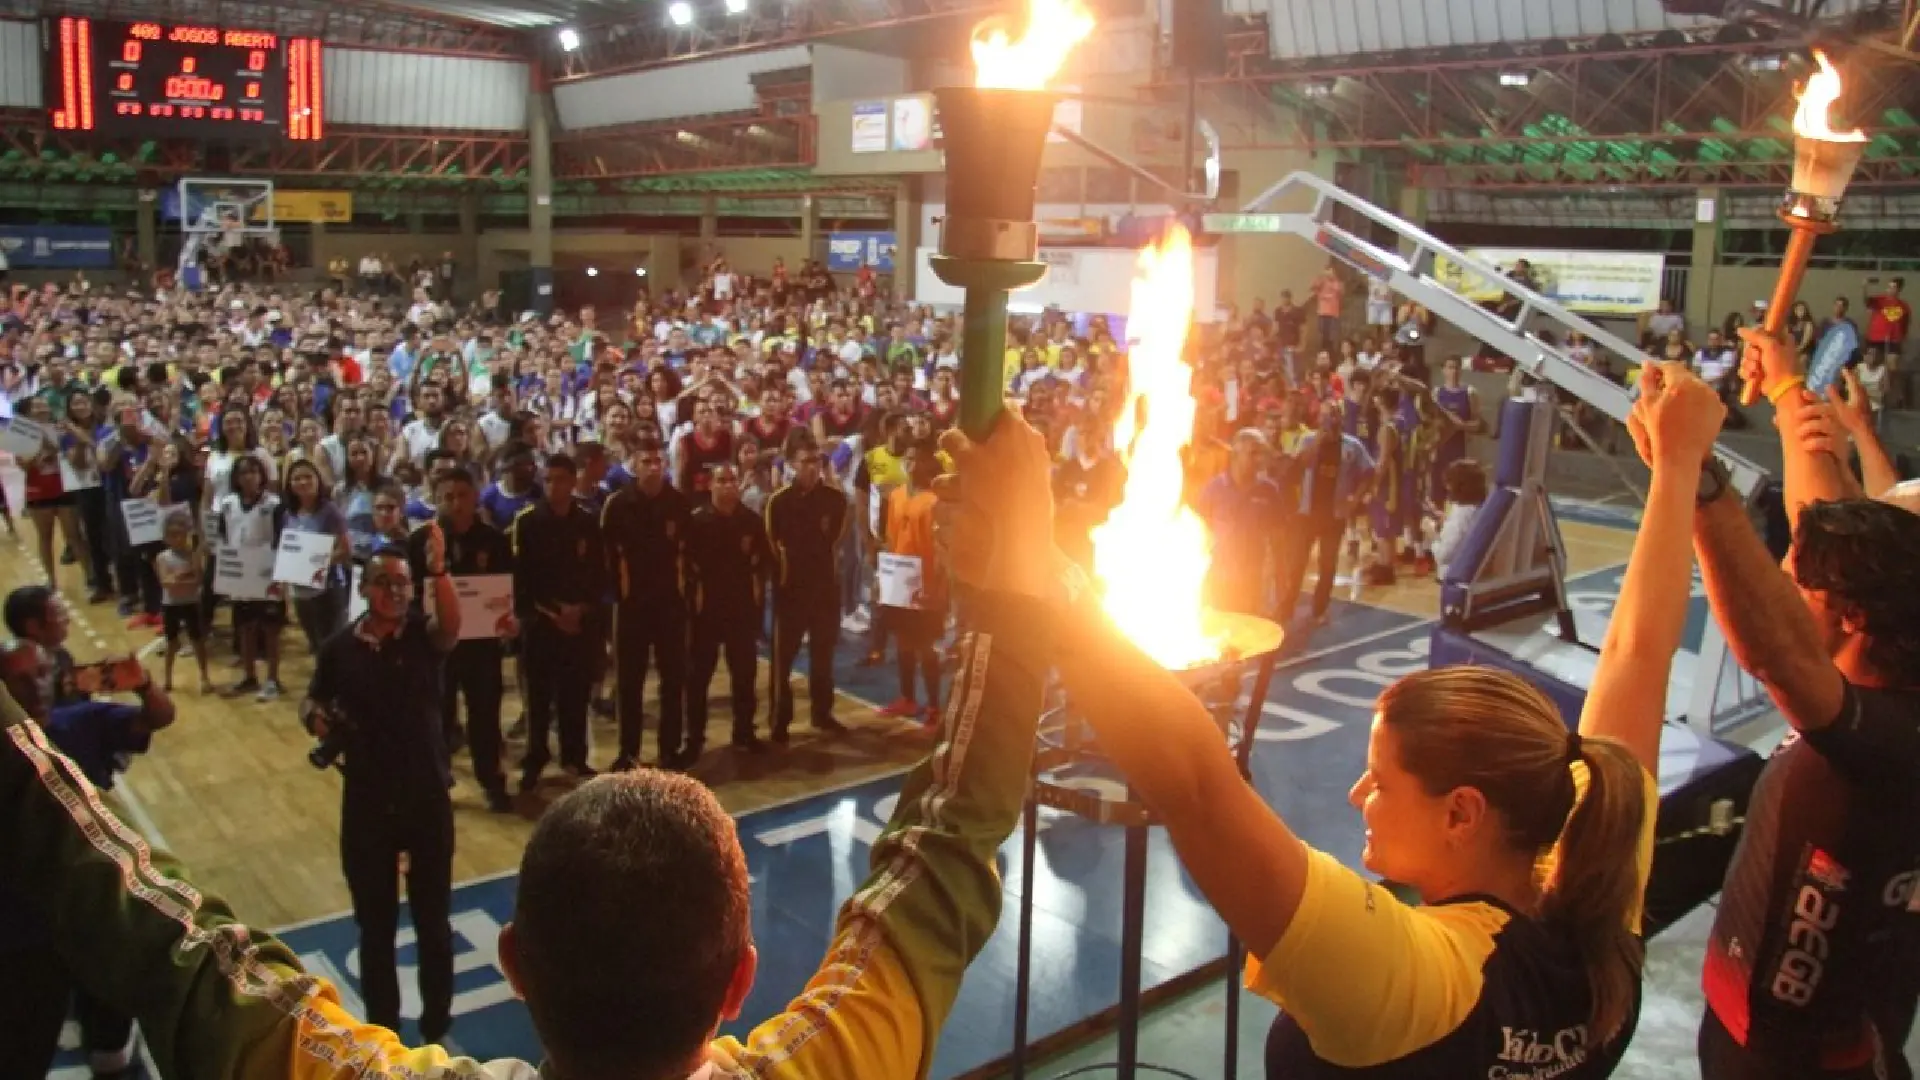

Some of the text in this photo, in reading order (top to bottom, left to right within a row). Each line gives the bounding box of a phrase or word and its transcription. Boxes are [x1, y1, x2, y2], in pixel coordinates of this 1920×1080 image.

[168, 26, 219, 44] JOGOS
[123, 39, 142, 62] 0
[249, 50, 266, 71] 0
